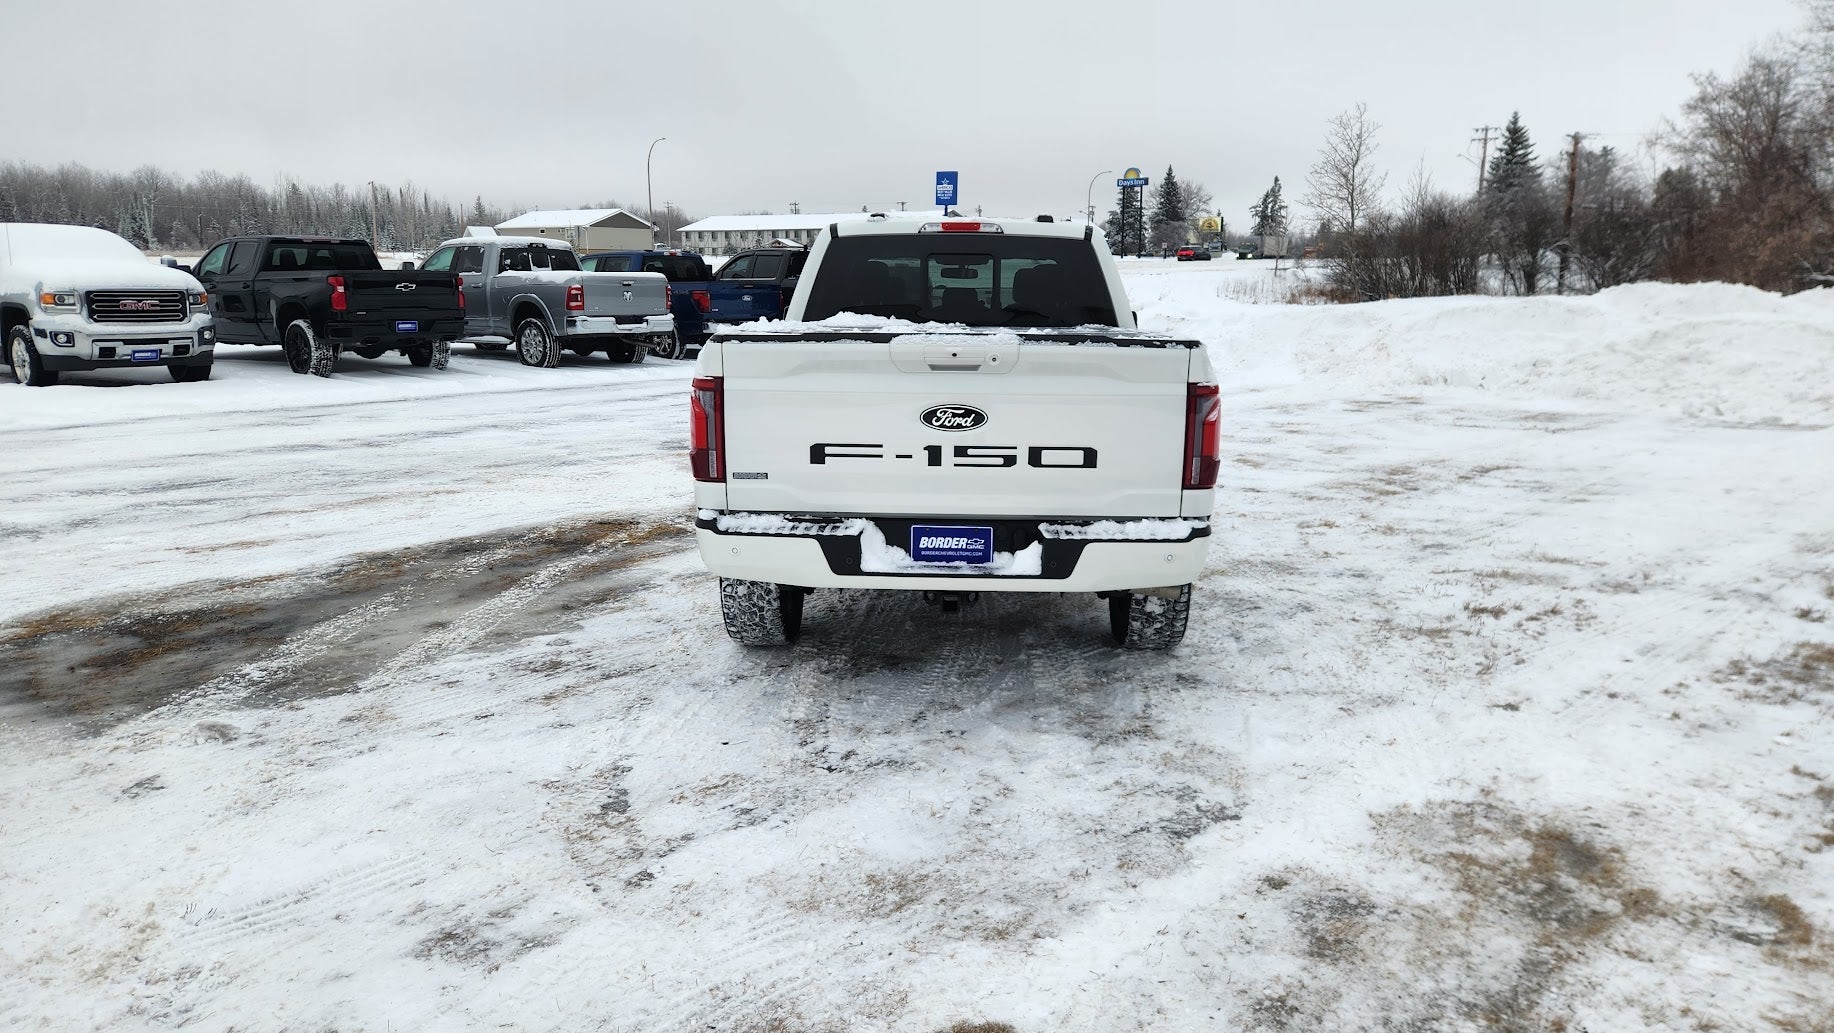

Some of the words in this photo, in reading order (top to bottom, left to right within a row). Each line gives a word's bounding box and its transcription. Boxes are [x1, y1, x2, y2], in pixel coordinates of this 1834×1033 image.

[119, 300, 161, 310] GMC
[931, 408, 975, 427] Ford
[809, 443, 1098, 468] F-150
[919, 536, 968, 549] BORDER
